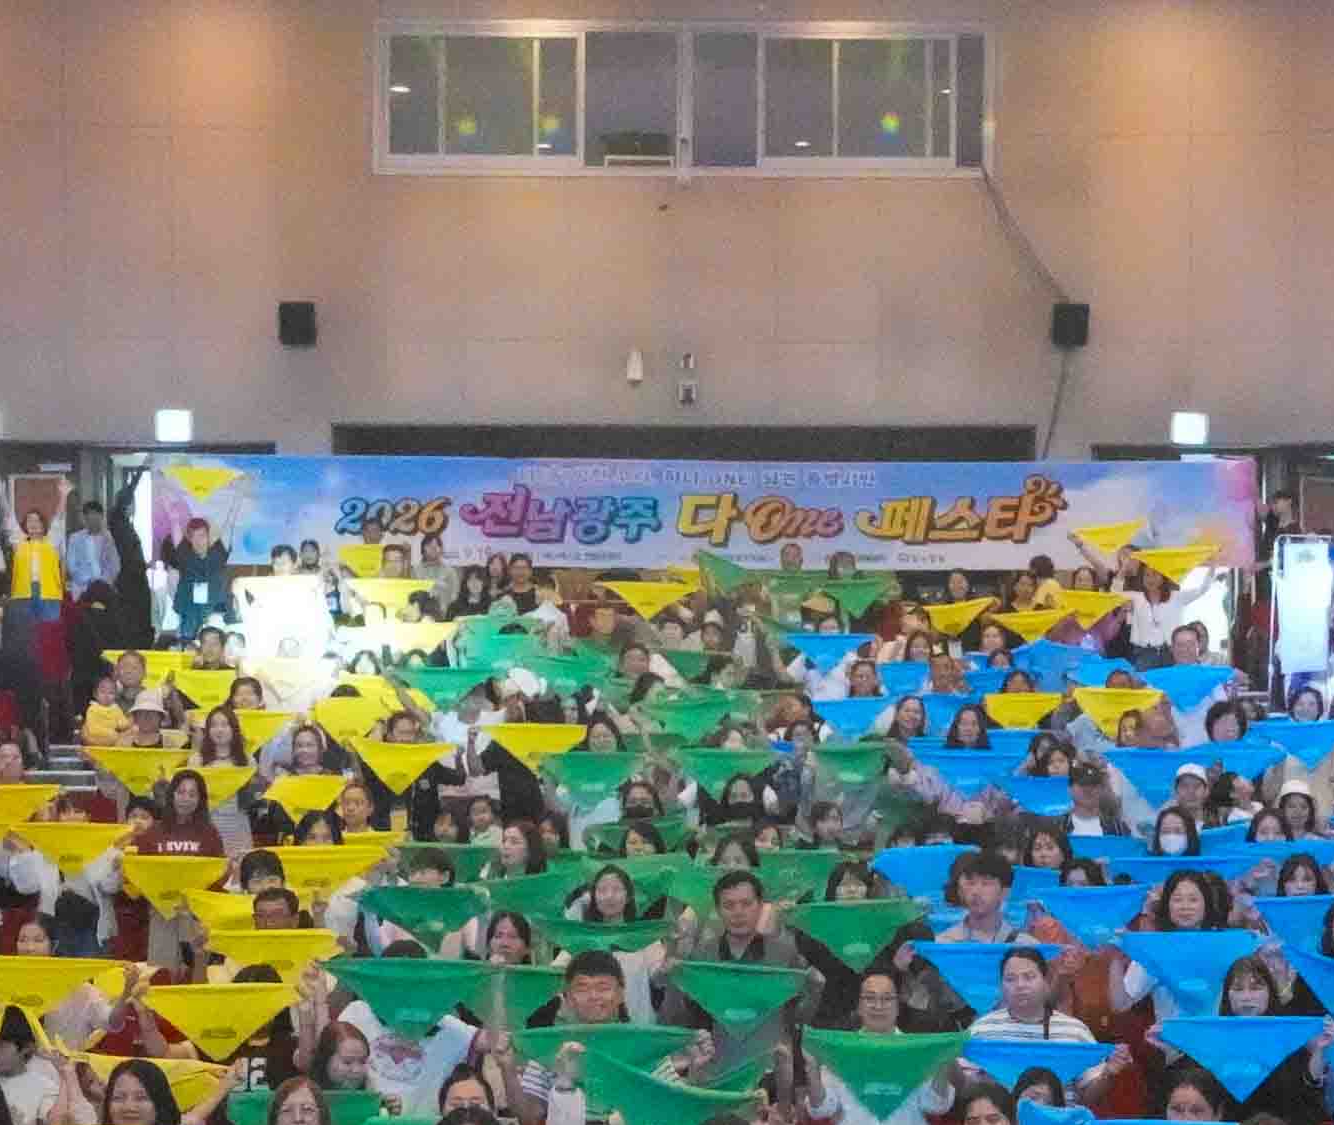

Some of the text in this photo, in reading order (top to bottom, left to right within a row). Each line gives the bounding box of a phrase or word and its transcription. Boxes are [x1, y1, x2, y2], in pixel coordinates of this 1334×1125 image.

[334, 495, 451, 537] 2026
[459, 483, 663, 544] 전남광주
[857, 474, 1068, 544] 페스타
